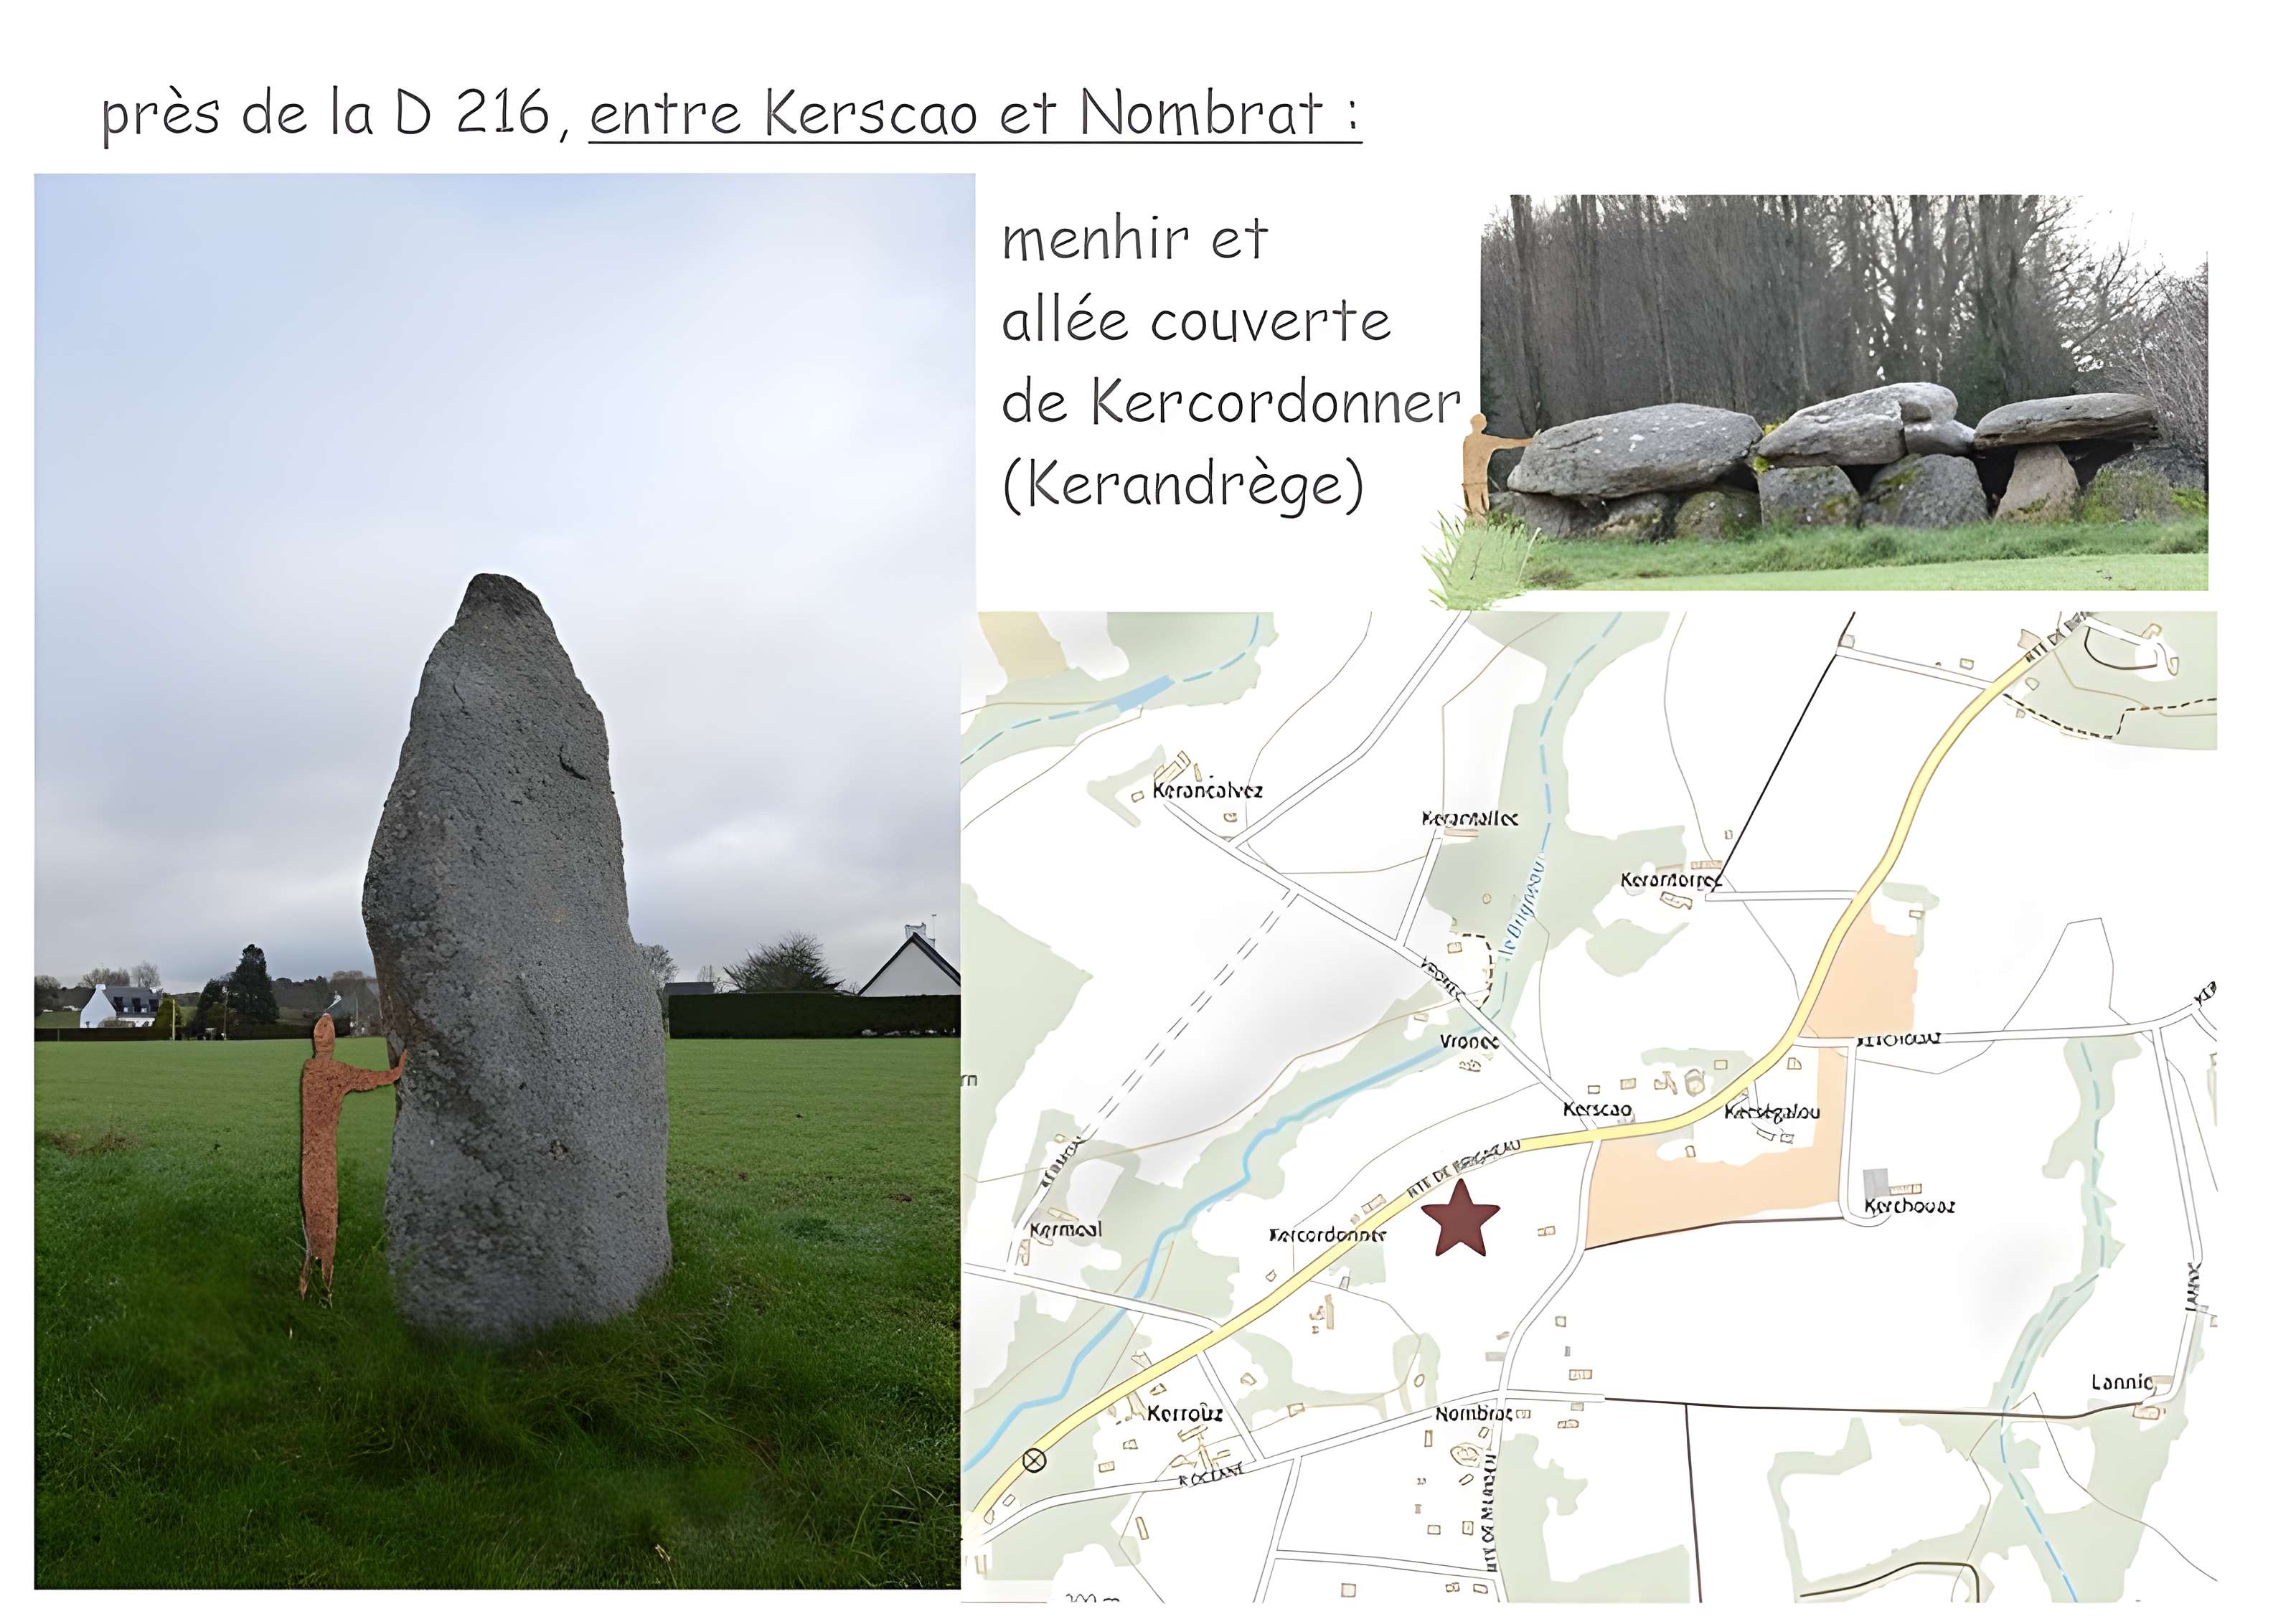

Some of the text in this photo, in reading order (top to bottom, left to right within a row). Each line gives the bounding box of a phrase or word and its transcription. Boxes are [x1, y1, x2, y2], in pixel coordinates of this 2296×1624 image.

[103, 85, 220, 150] près
[243, 85, 307, 135] de
[332, 85, 373, 135] la
[397, 88, 431, 135] D
[458, 88, 568, 143] 216,
[591, 92, 741, 136] entre
[767, 88, 977, 136] Kerscao
[1001, 92, 1057, 136] et
[1082, 87, 1323, 136] Nombrat
[1004, 212, 1269, 261] menhir et
[1002, 292, 1391, 343] allée couverte
[1002, 375, 1462, 425] de Kercordonner
[1004, 455, 1363, 519] (Kerandrège)
